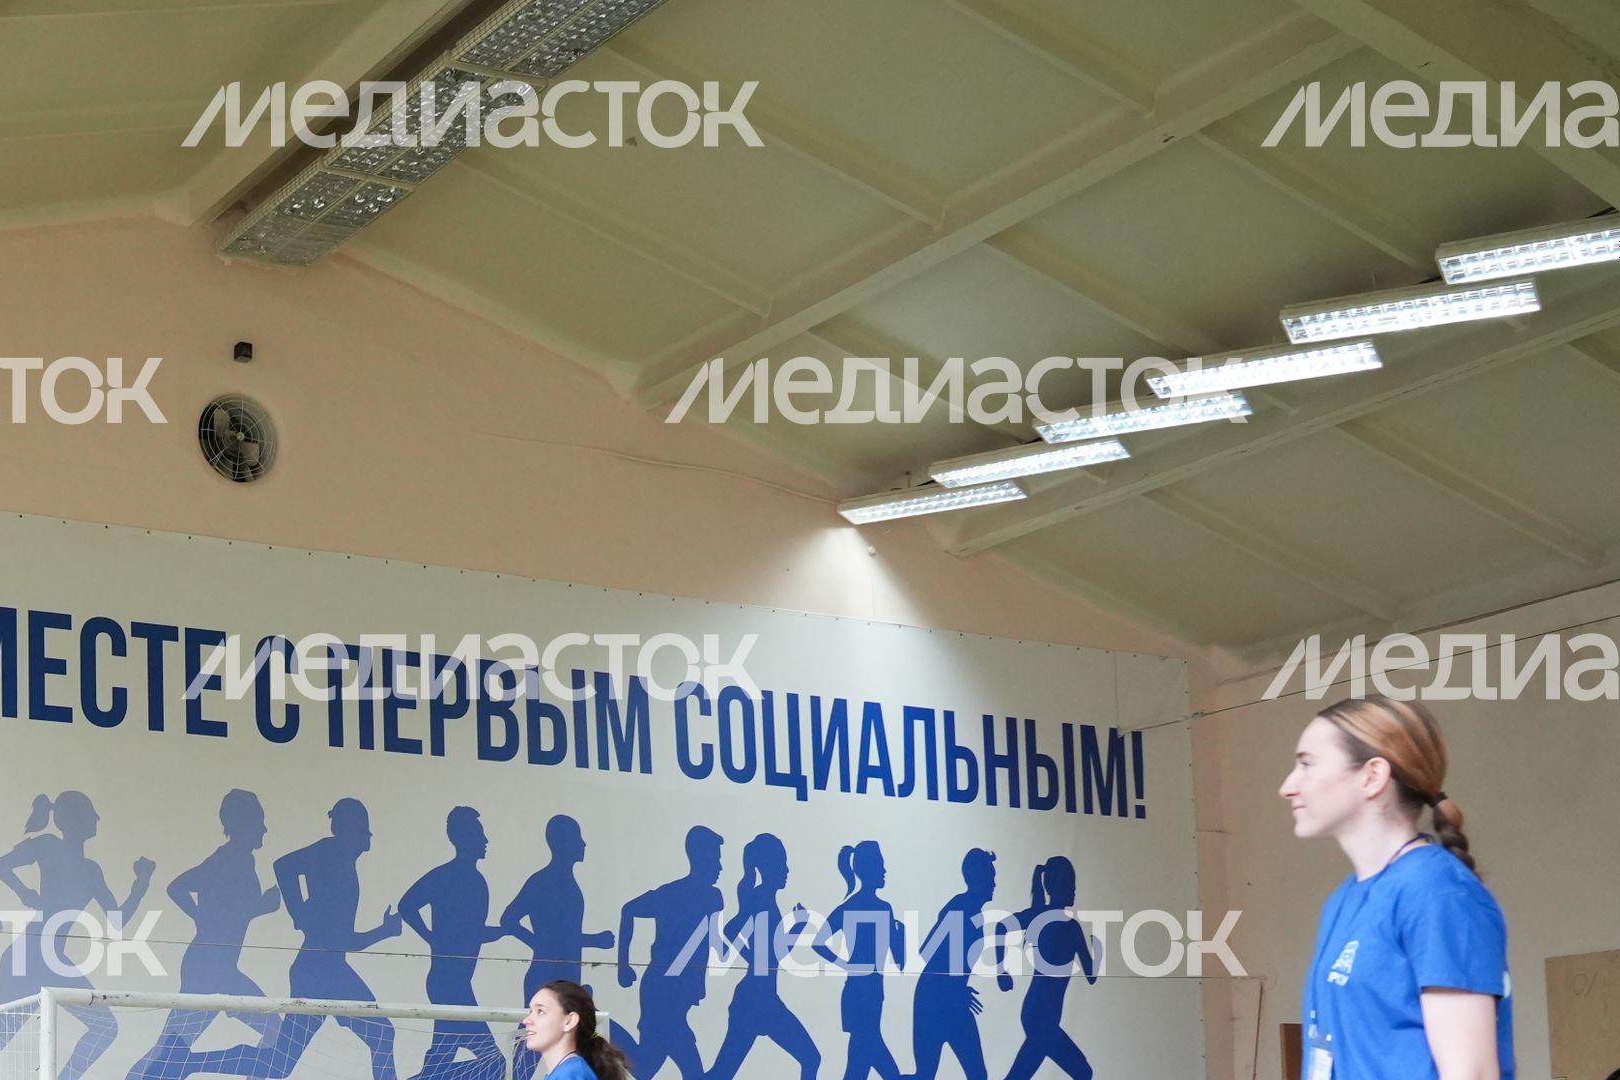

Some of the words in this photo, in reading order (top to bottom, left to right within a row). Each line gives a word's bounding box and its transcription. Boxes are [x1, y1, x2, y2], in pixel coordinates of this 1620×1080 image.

[254, 635, 301, 745] С
[326, 642, 653, 775] ПЕРВЫМ
[674, 679, 1147, 820] СОЦИАЛЬНЫМ!
